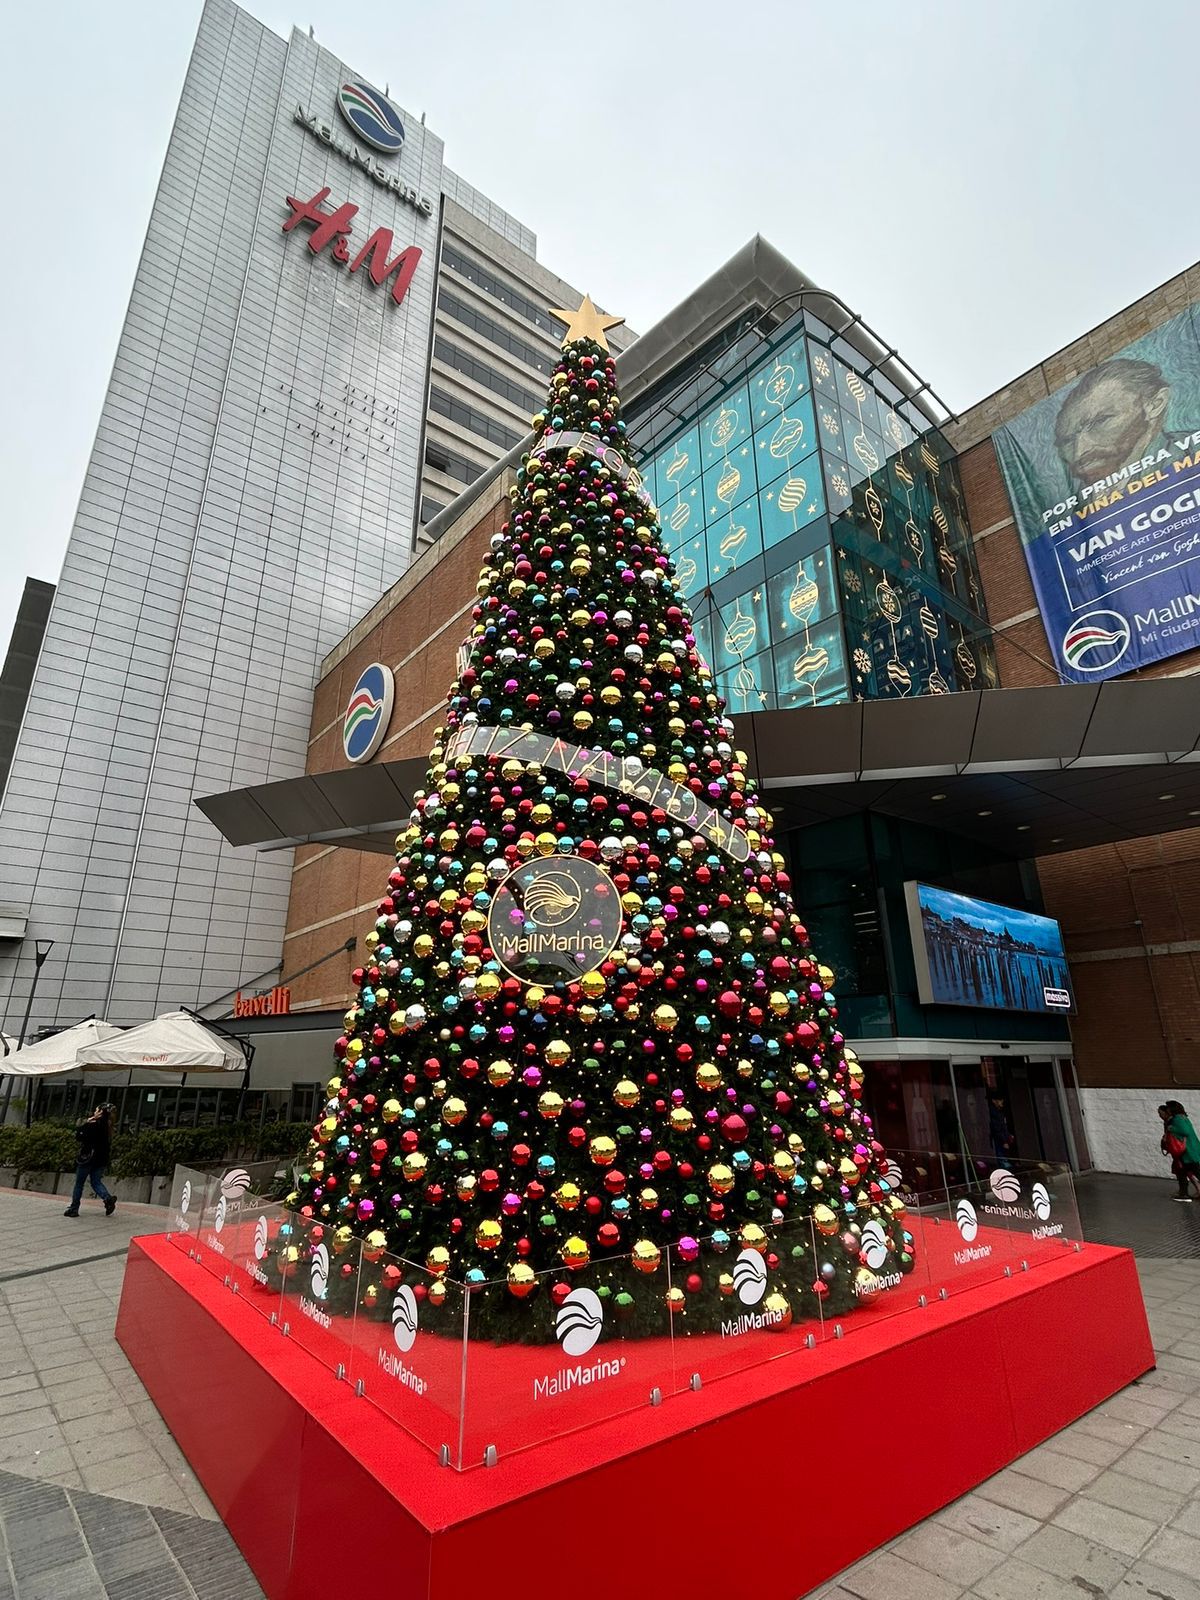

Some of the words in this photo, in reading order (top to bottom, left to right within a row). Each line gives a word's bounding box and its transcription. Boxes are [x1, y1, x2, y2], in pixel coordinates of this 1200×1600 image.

[283, 186, 423, 305] H&M
[1042, 495, 1079, 523] POR
[1081, 448, 1172, 500] PRIMERA
[1048, 516, 1073, 537] EN
[1075, 490, 1124, 520] VIÑA
[1127, 470, 1169, 495] DEL
[1068, 523, 1126, 562] VAN
[1076, 544, 1129, 575] IMMERSIVE
[1130, 533, 1151, 550] ART
[1152, 513, 1200, 539] EXPERIE
[1101, 555, 1144, 584] Vincent
[1141, 630, 1158, 645] Mi
[1160, 616, 1200, 638] ciuda
[541, 736, 752, 863] NAVIDAD
[501, 930, 605, 954] MallMarina
